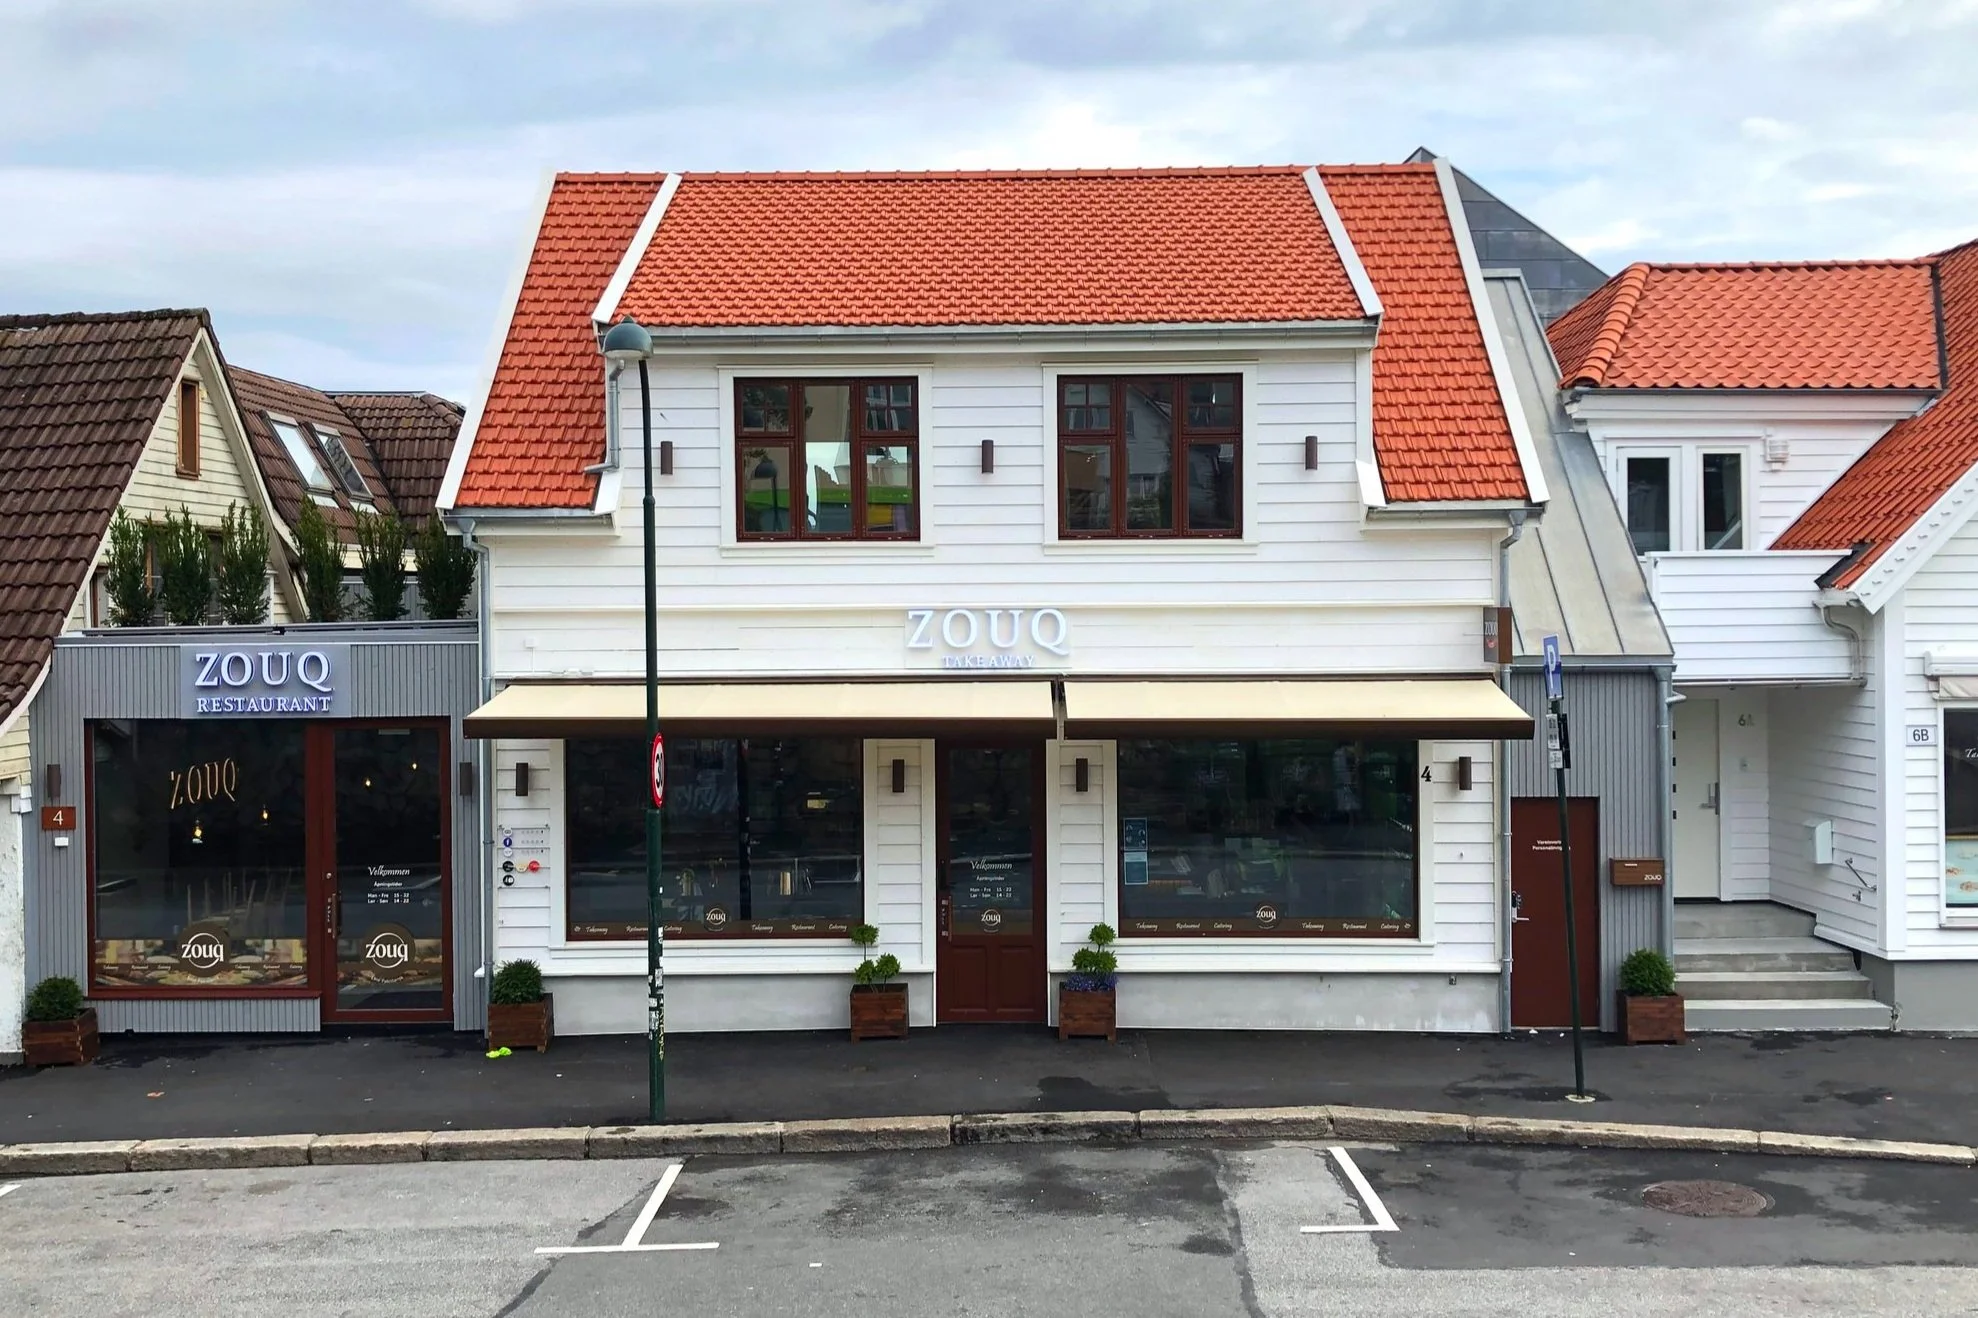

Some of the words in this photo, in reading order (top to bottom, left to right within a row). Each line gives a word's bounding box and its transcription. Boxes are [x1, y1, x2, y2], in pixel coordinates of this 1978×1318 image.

[906, 608, 1069, 656] ZOUQ
[943, 655, 1035, 668] TAKEAWAY
[195, 651, 334, 692] ZOUQ
[196, 696, 332, 713] RESTAURANT
[1912, 728, 1930, 742] 6B
[1420, 765, 1432, 782] 4
[170, 758, 236, 809] ZOUQ
[52, 810, 64, 826] 4
[367, 864, 410, 877] Velkommen
[970, 859, 1013, 871] Velkommen
